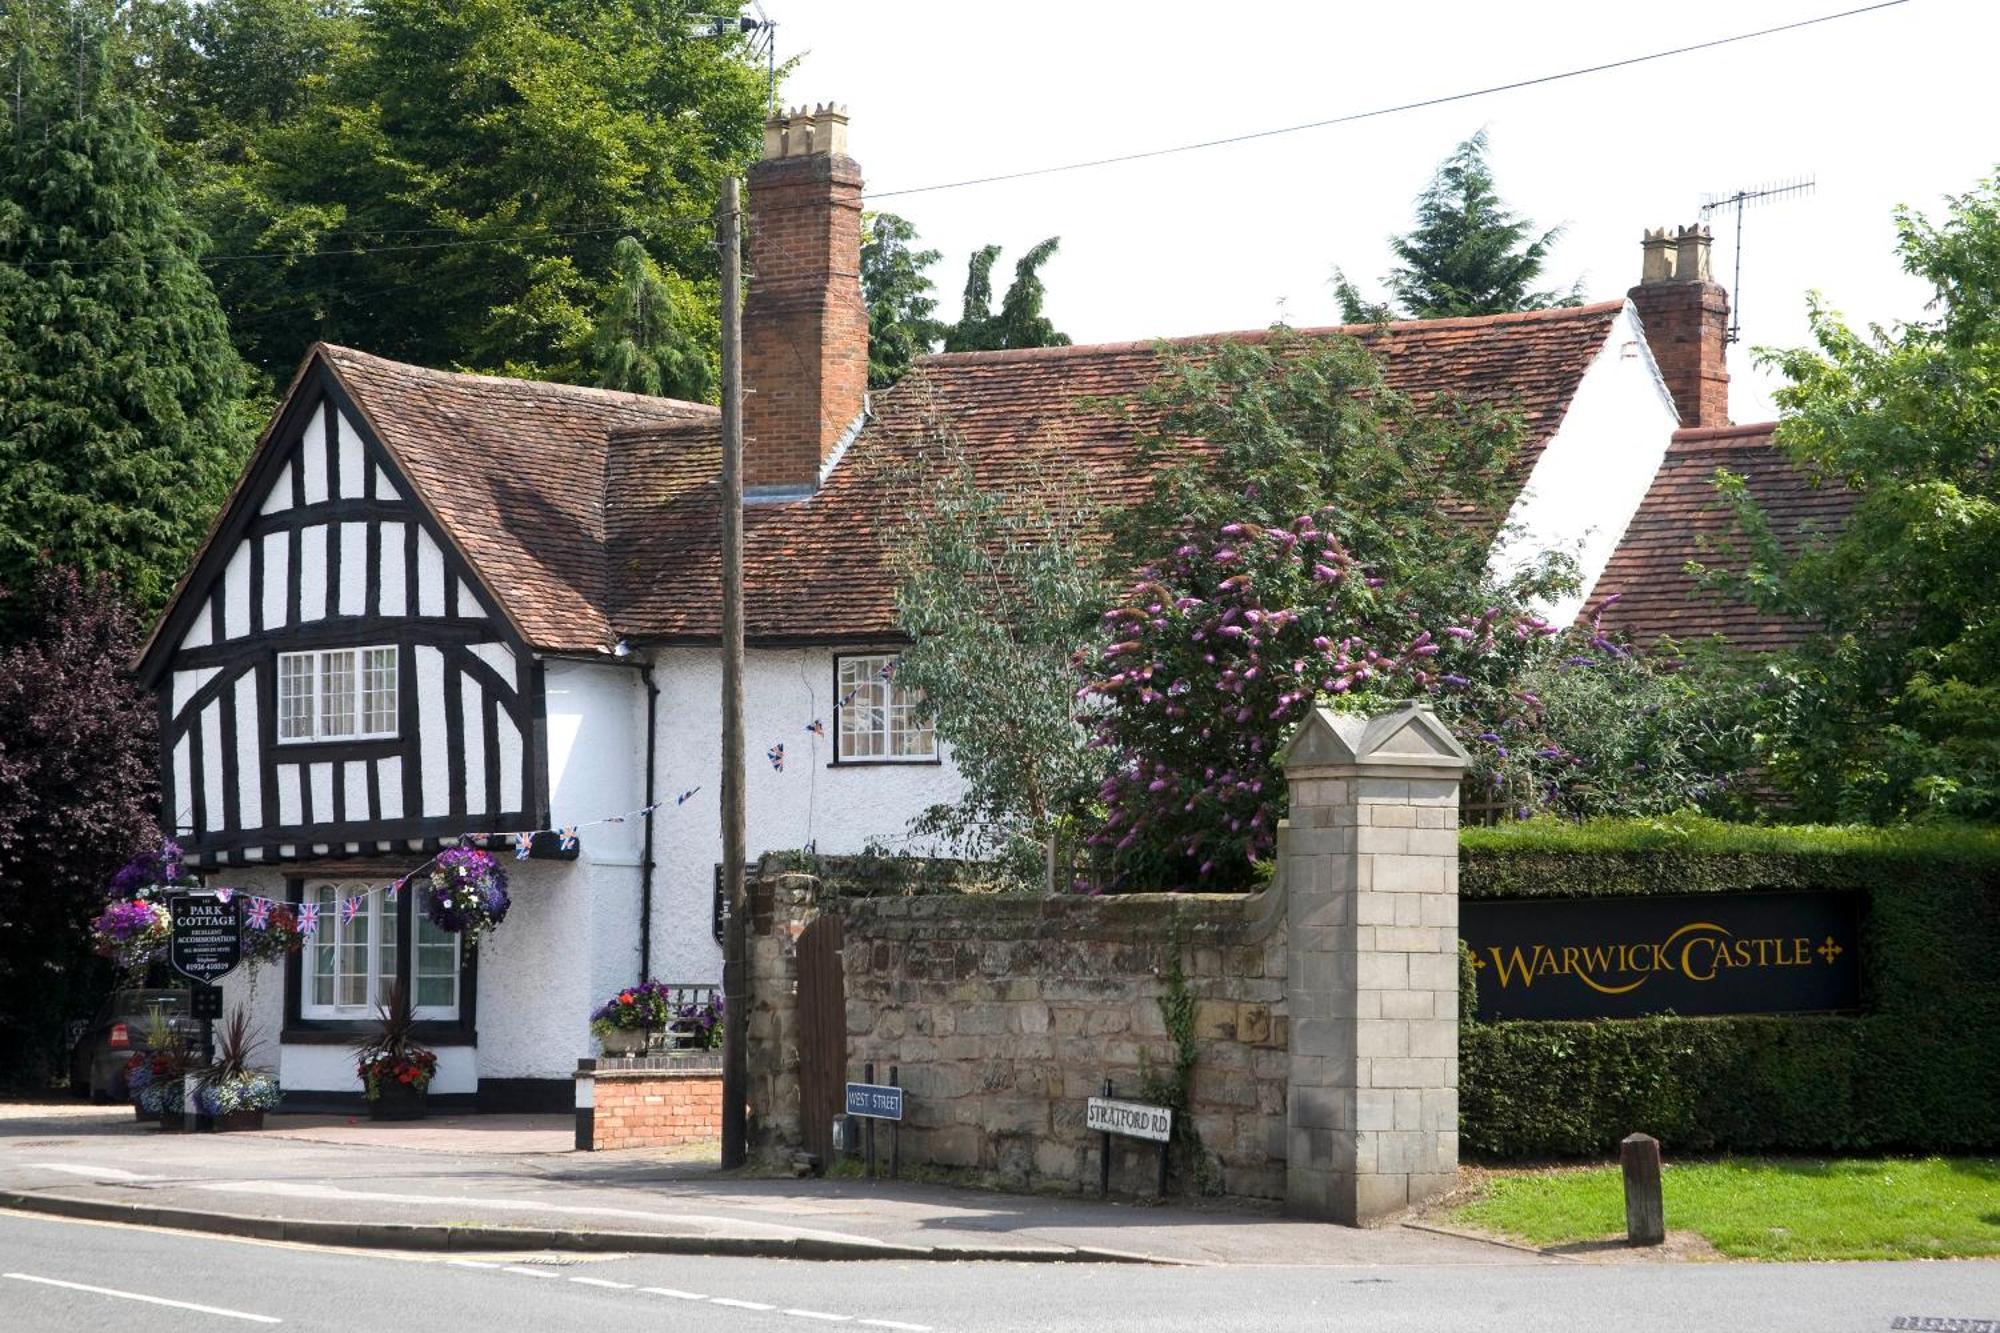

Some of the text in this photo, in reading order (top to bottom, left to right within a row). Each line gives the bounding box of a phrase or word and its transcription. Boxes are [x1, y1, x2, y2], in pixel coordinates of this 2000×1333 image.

[190, 906, 223, 915] PARK
[177, 916, 236, 926] COTTAGE
[1488, 936, 1813, 994] WARWICK CASTLE
[848, 1091, 899, 1110] WEST STREET
[1089, 1104, 1150, 1130] STRATFORD
